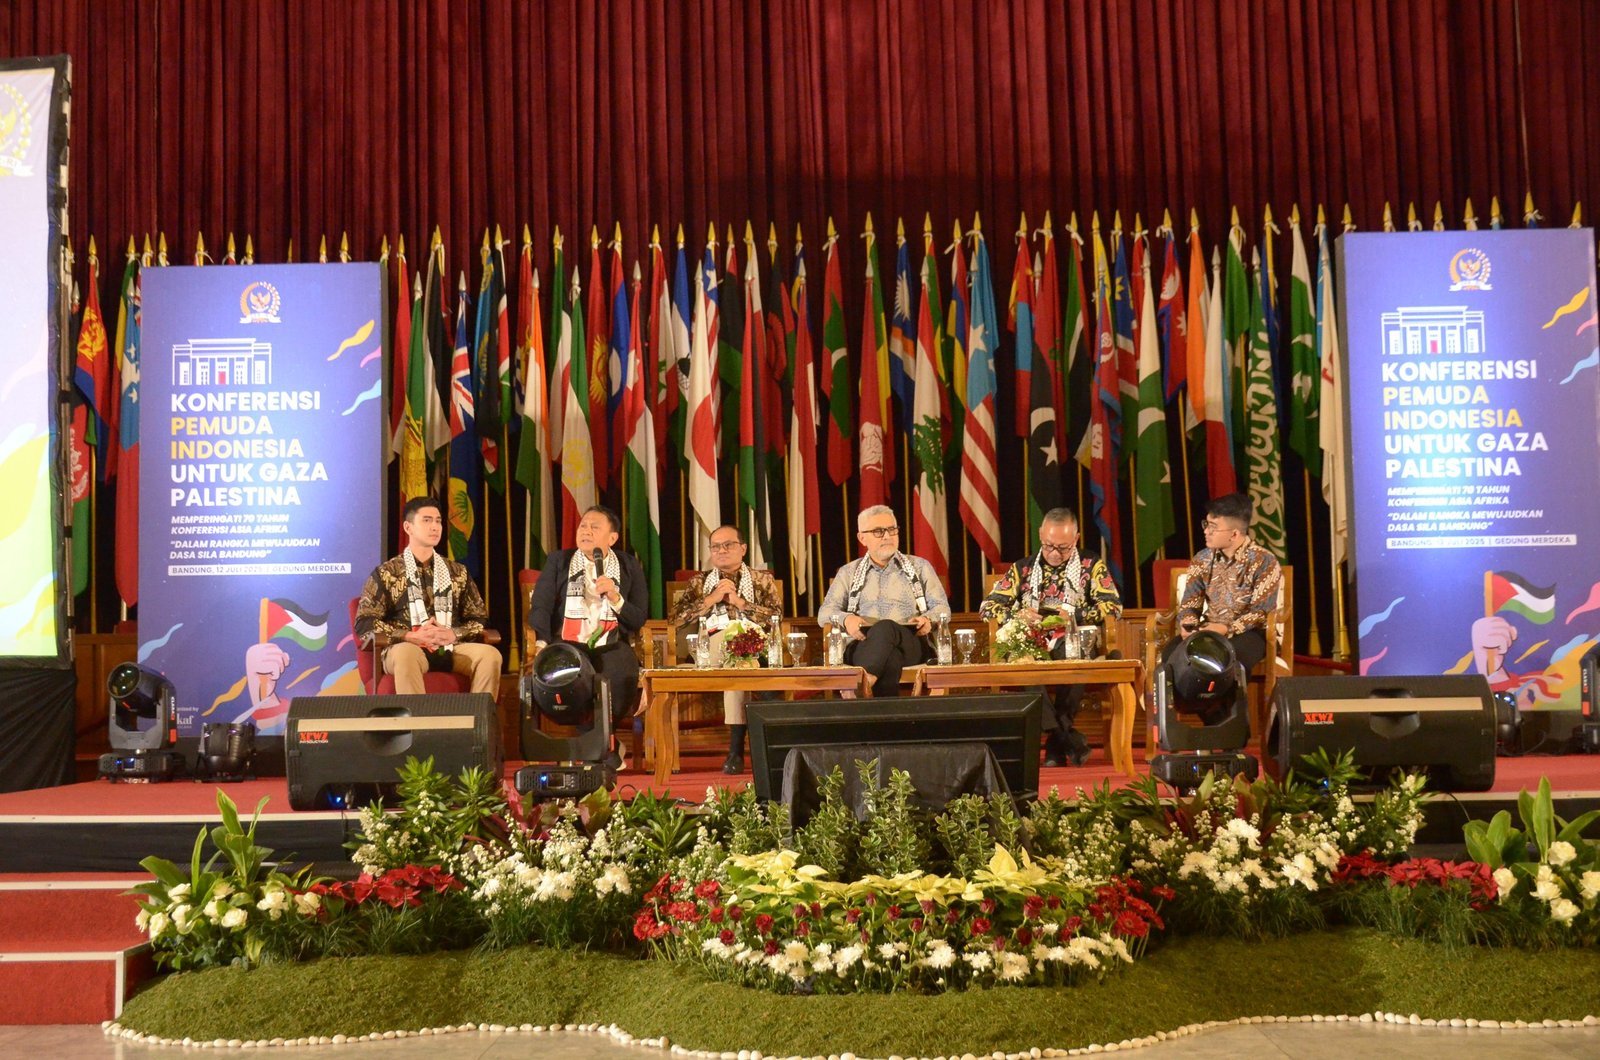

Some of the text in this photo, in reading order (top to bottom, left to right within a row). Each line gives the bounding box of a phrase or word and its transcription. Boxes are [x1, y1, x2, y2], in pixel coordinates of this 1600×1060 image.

[1382, 360, 1537, 382] KONFERENSI
[171, 391, 321, 412] KONFERENSI
[1383, 385, 1489, 406] PEMUDA
[1384, 409, 1523, 430] INDONESIA
[171, 416, 273, 436] PEMUDA
[171, 439, 304, 460] INDONESIA
[1384, 432, 1549, 455] UNTUK GAZA
[170, 462, 328, 483] UNTUK GAZA
[1385, 457, 1522, 479] PALESTINA
[1476, 485, 1510, 494] TAHUN
[170, 487, 301, 507] PALESTINA
[1473, 496, 1510, 505] AFRIKA
[171, 514, 242, 524] MEMPERINGATI
[243, 514, 255, 523] 70
[1472, 509, 1543, 520] MEWUJUDKAN
[171, 525, 229, 535] KONFERENSI
[230, 525, 252, 534] ASIA
[1387, 523, 1414, 532] DASA
[209, 539, 250, 548] RANGKA
[251, 538, 320, 548] MEWUJUDKAN
[1465, 538, 1485, 546] 2025
[1494, 537, 1530, 545] GEDUNG
[1531, 536, 1571, 544] MERDEKA
[170, 551, 195, 560] DASA
[197, 550, 218, 559] SILA
[172, 566, 215, 574] BANDUNG,
[216, 565, 224, 573] 12
[272, 564, 306, 573] GEDUNG
[307, 564, 346, 573] MERDEKA
[176, 713, 194, 725] kaf
